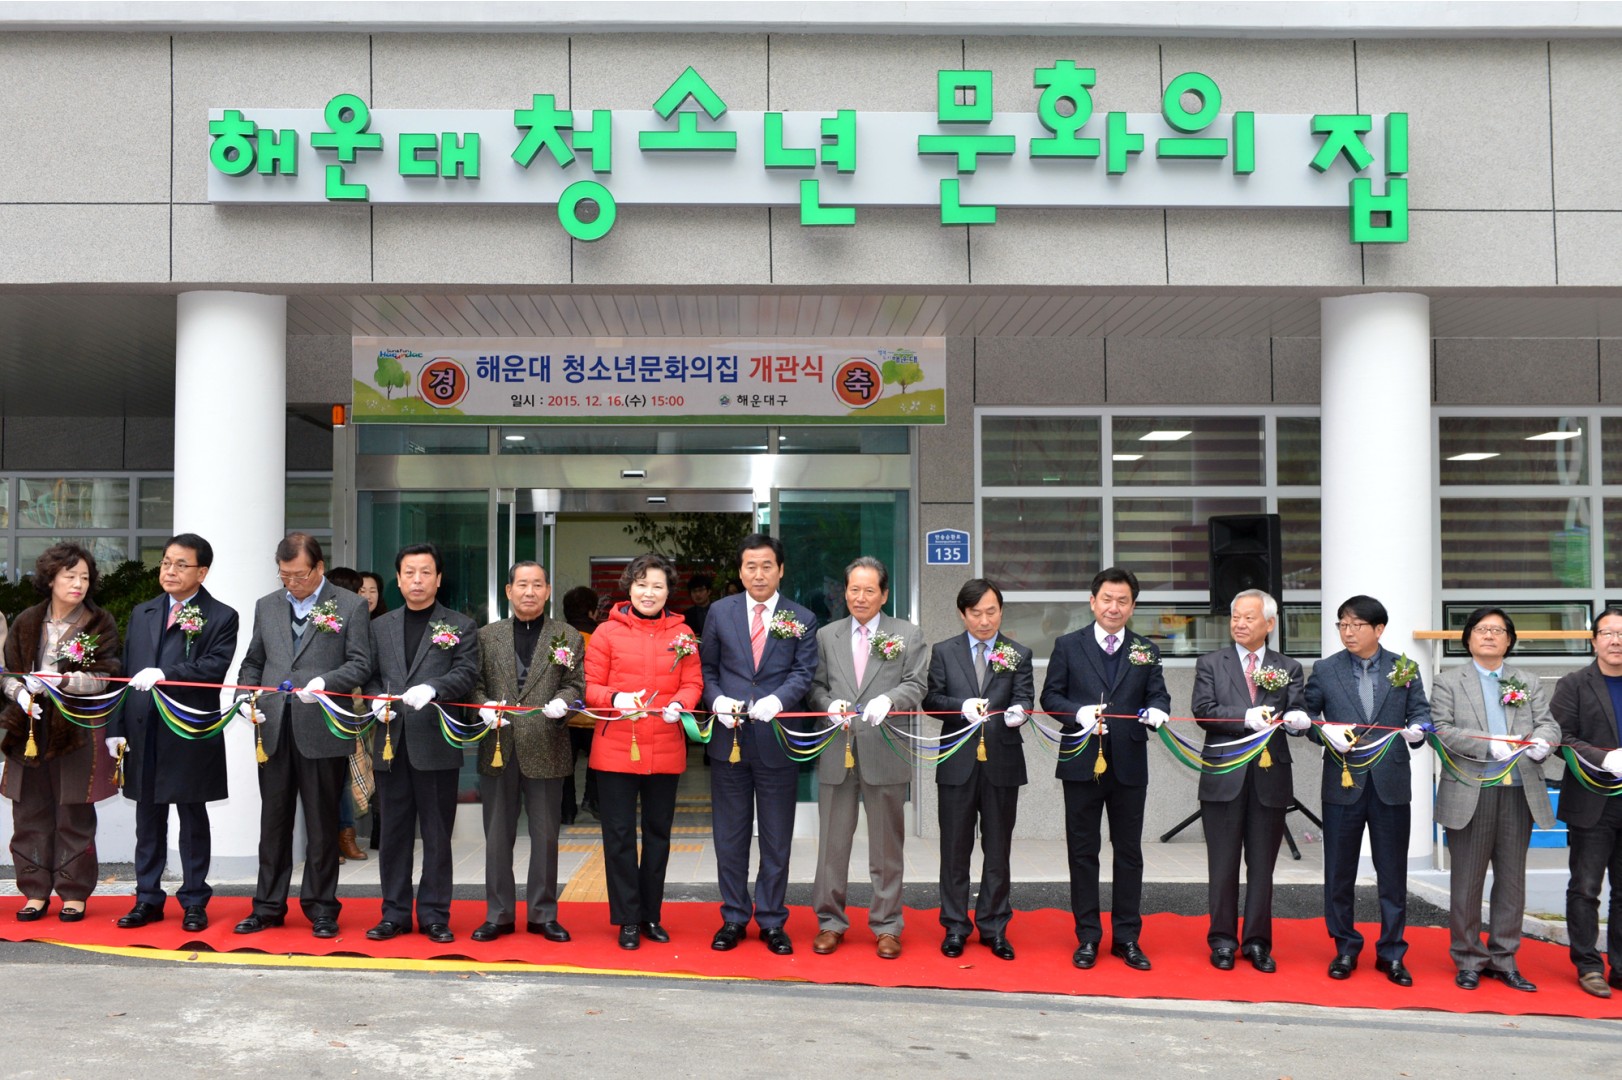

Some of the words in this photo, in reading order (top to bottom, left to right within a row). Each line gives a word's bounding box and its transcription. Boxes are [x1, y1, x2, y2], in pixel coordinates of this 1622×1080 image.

[209, 94, 480, 201] 해운대
[511, 66, 856, 241] 청소년
[917, 60, 1256, 225] 문화의
[1308, 112, 1408, 243] 집
[428, 367, 456, 400] 경
[476, 354, 551, 383] 해운대
[562, 354, 738, 384] 청소년문화의집
[749, 355, 824, 384] 개관식
[843, 367, 874, 400] 축
[510, 394, 535, 408] 일시
[548, 396, 580, 407] 2015.
[585, 396, 602, 407] 12.
[651, 395, 685, 407] 15:00
[736, 394, 788, 408] 해운대구
[935, 547, 961, 561] 135
